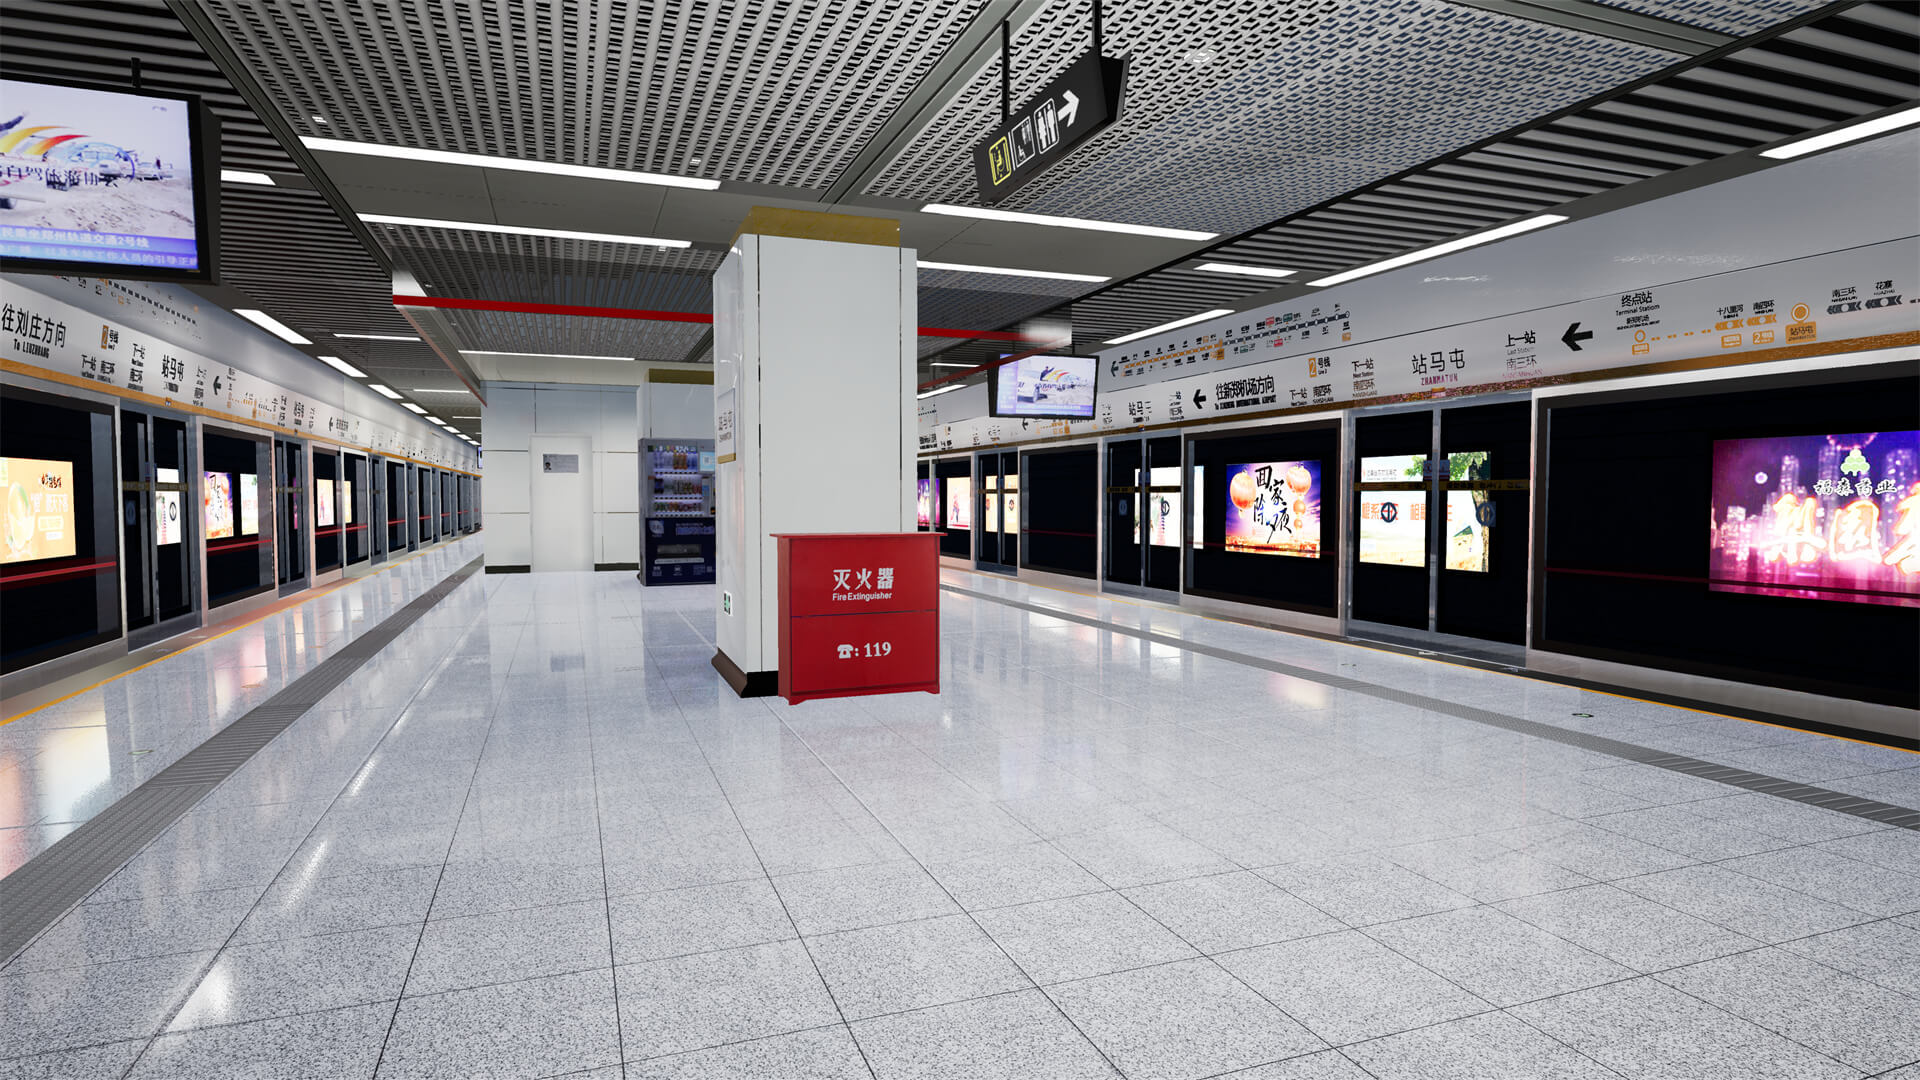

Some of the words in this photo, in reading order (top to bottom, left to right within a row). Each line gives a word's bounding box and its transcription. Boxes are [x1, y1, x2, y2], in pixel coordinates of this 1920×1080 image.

[1621, 290, 1653, 307] 终点站
[1615, 307, 1638, 316] Terminal
[1, 303, 67, 349] 往刘庄方向
[14, 338, 20, 351] To
[1505, 329, 1536, 347] 上一站
[161, 354, 185, 382] 站马屯
[1352, 357, 1374, 372] 下一站
[1411, 347, 1465, 375] 站马屯
[1506, 355, 1537, 371] 南三环
[1215, 374, 1275, 400] 往新郑机场方向
[1421, 373, 1458, 386] ZHANMATUN
[1289, 386, 1308, 400] 下一站
[833, 567, 894, 591] 灭火器
[832, 592, 847, 601] Fire
[848, 592, 892, 602] Extinguisher
[864, 641, 892, 657] 119
